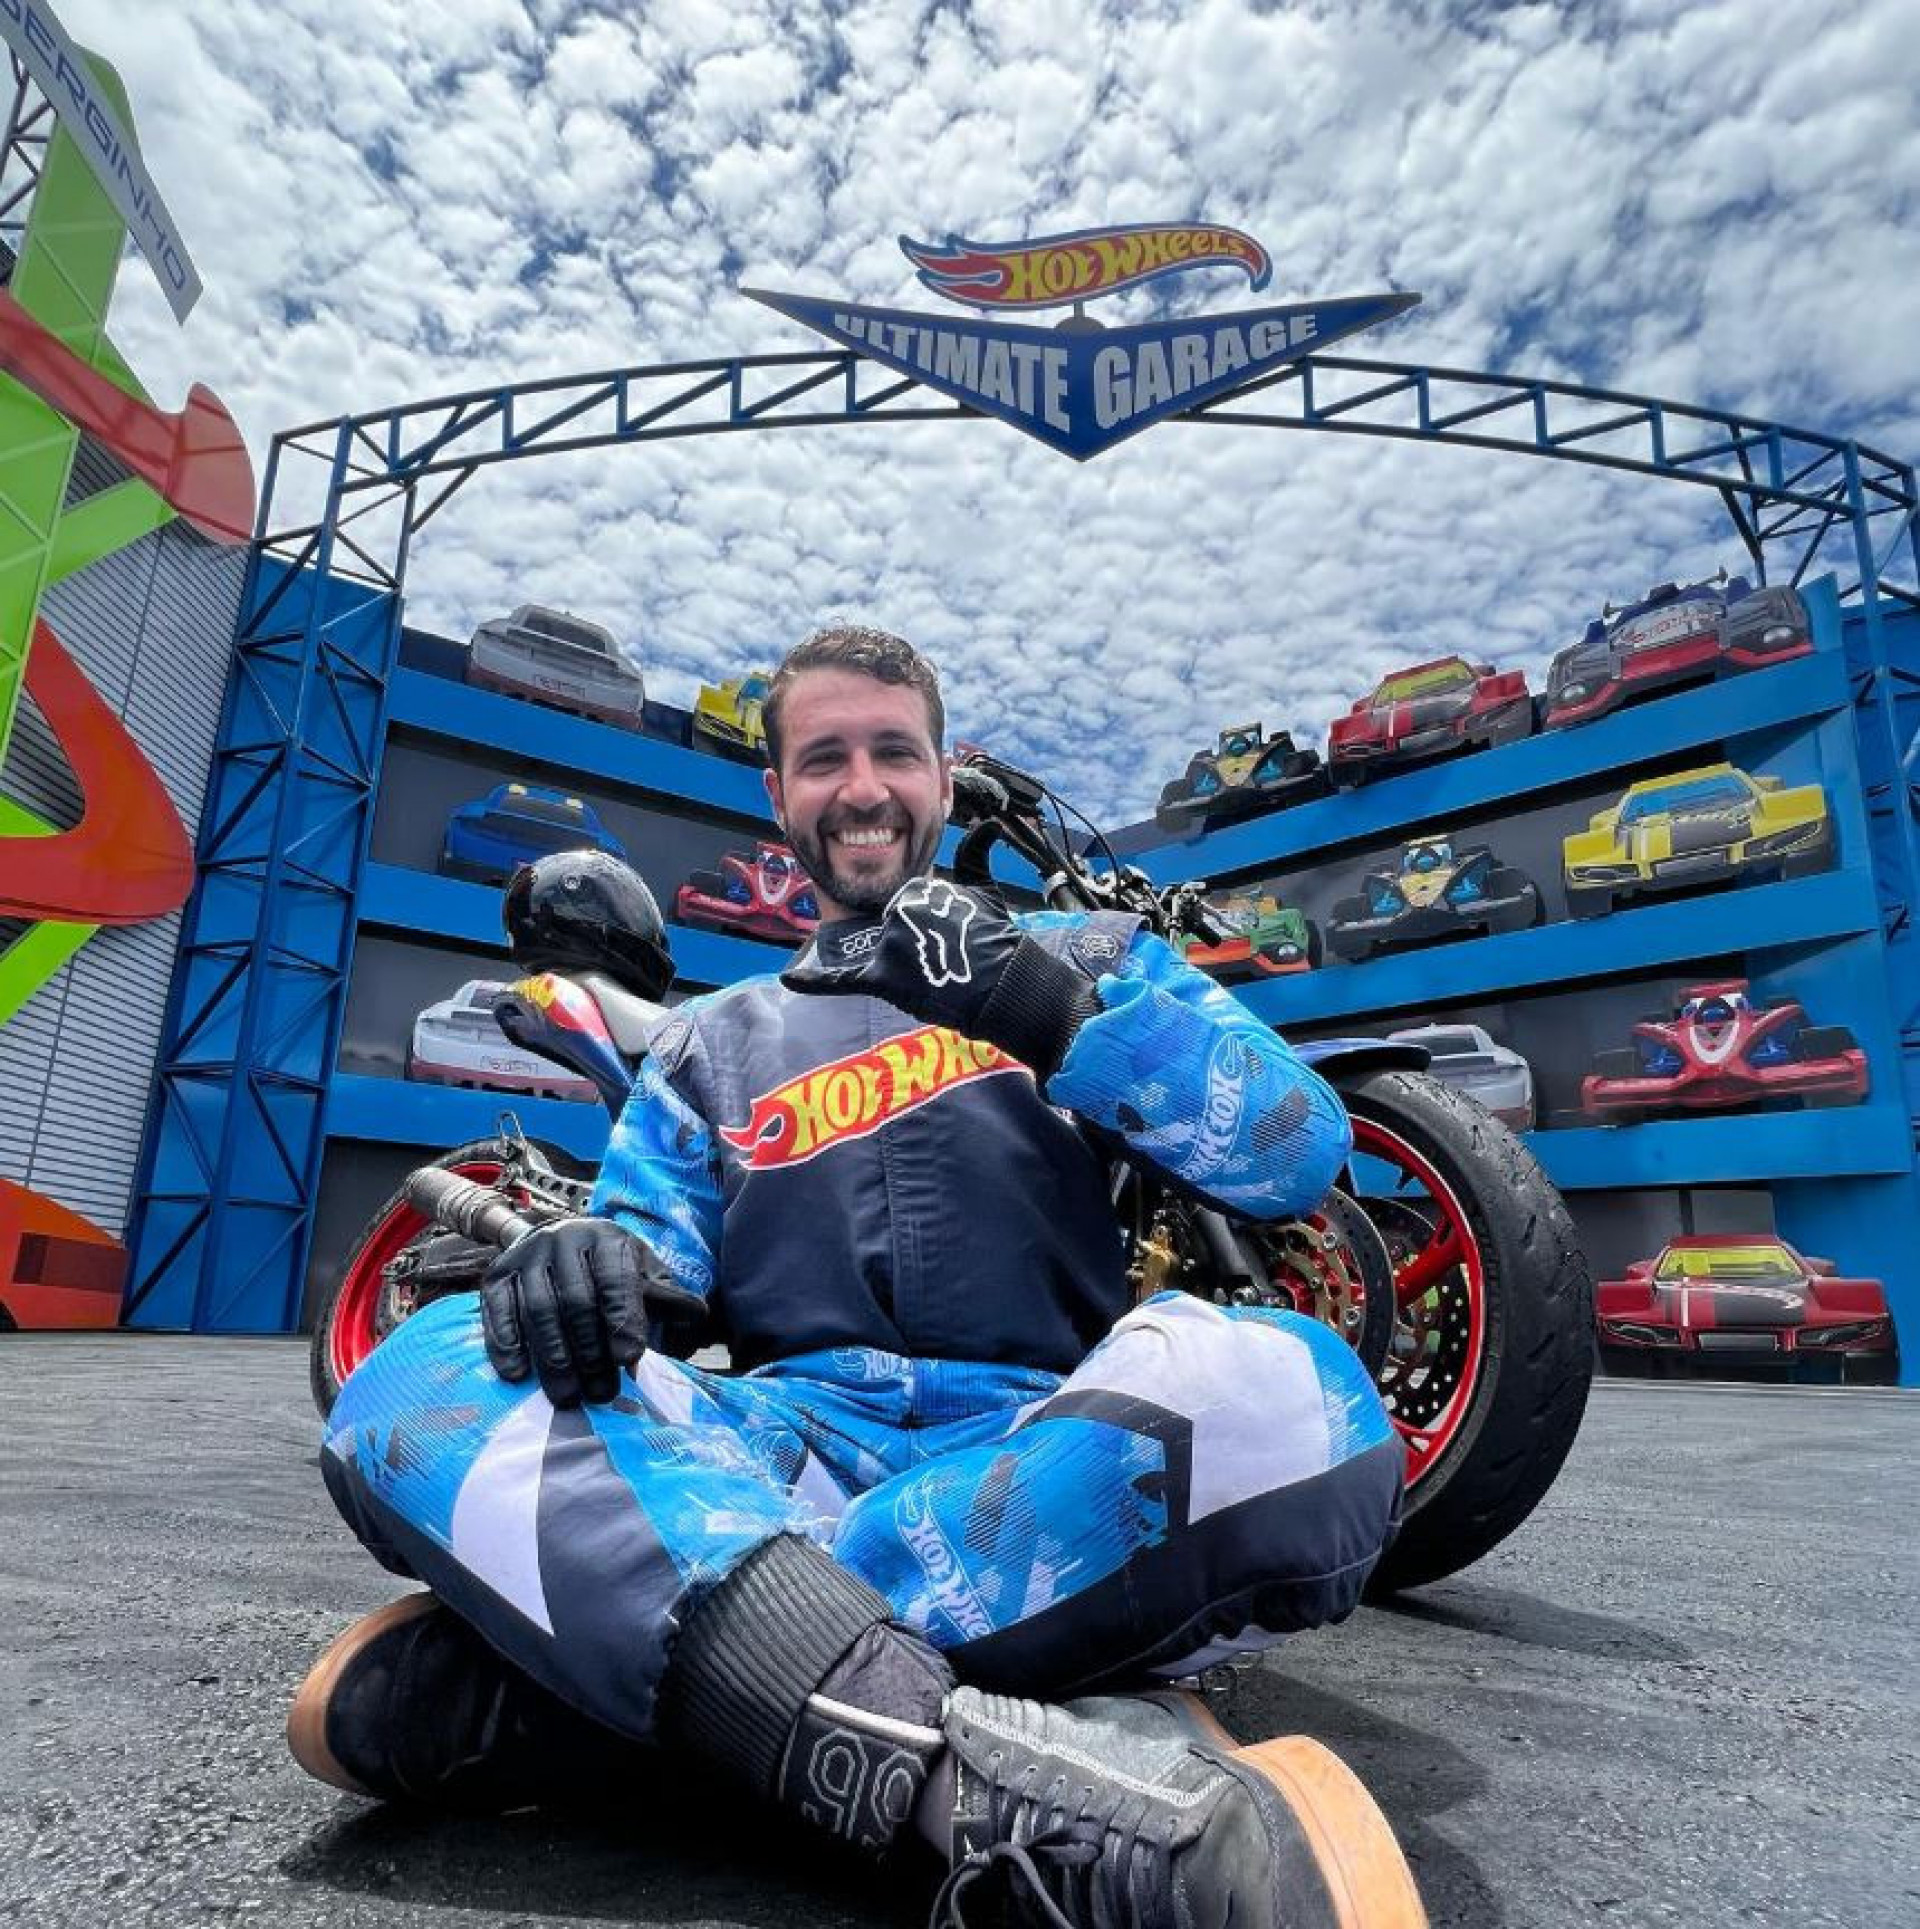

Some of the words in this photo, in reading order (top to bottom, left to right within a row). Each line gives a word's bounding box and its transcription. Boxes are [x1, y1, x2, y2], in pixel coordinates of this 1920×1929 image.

[998, 248, 1097, 300] HOT
[834, 313, 1070, 433] ULTIMATE
[1093, 313, 1318, 430] GARAGE
[777, 1064, 882, 1158] HOT
[901, 1509, 952, 1583] HOT
